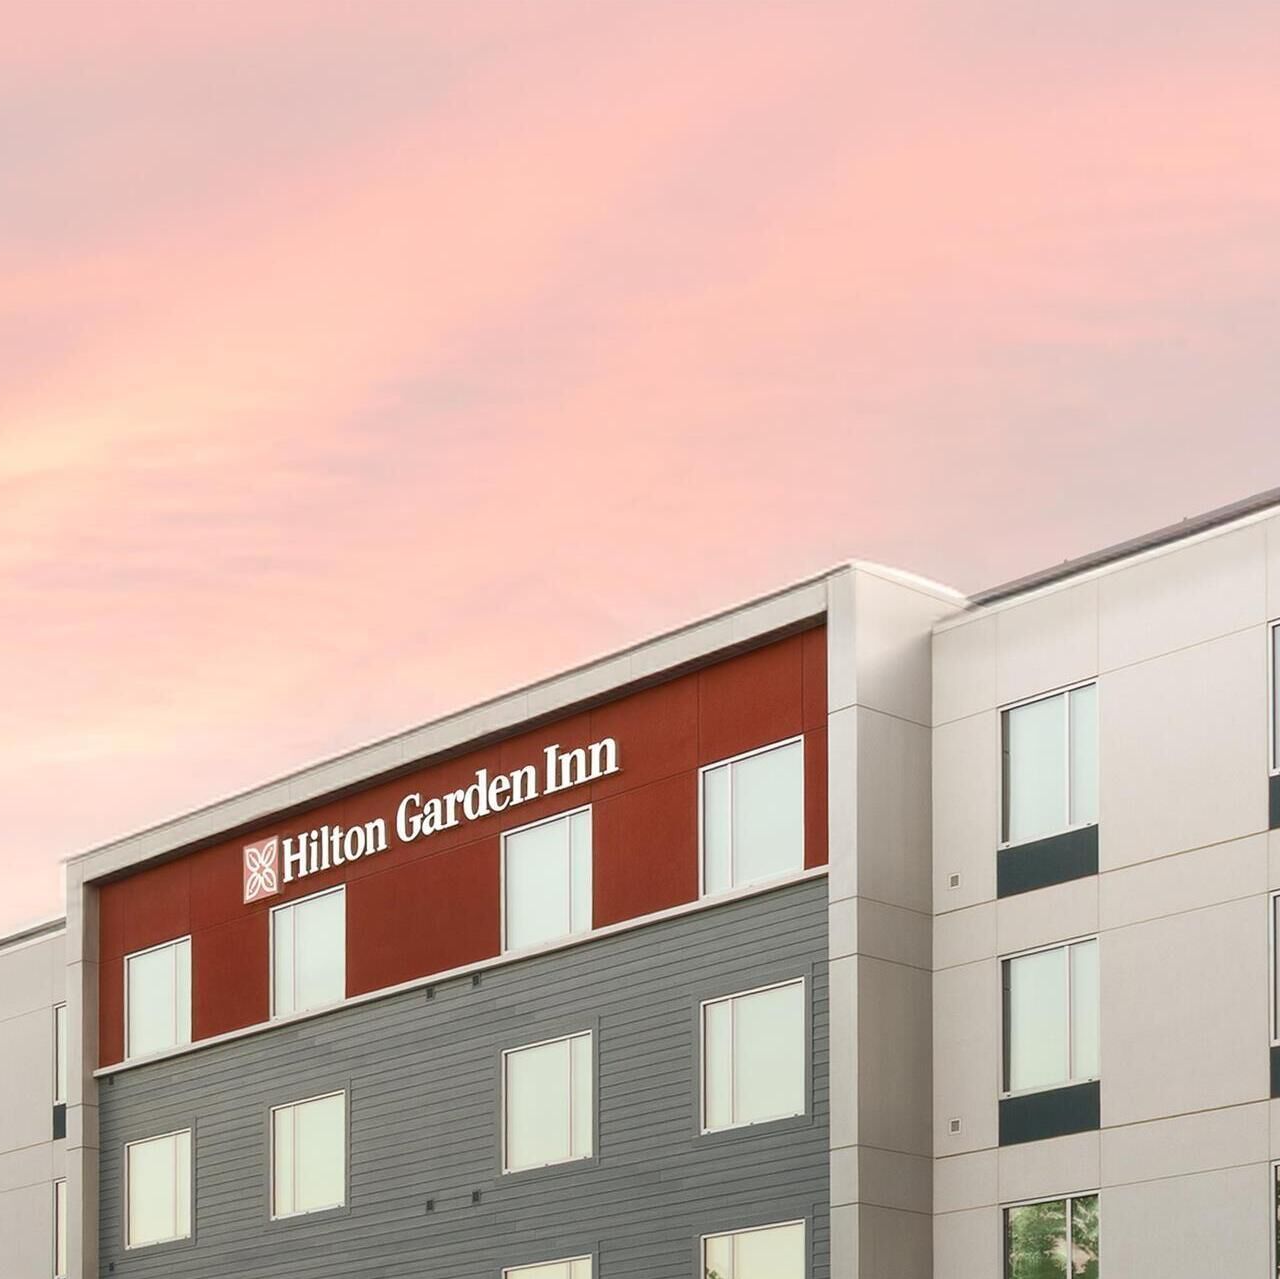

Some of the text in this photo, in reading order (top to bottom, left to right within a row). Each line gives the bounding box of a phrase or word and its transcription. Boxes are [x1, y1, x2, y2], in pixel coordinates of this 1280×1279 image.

[282, 736, 620, 883] Hilton Garden Inn
